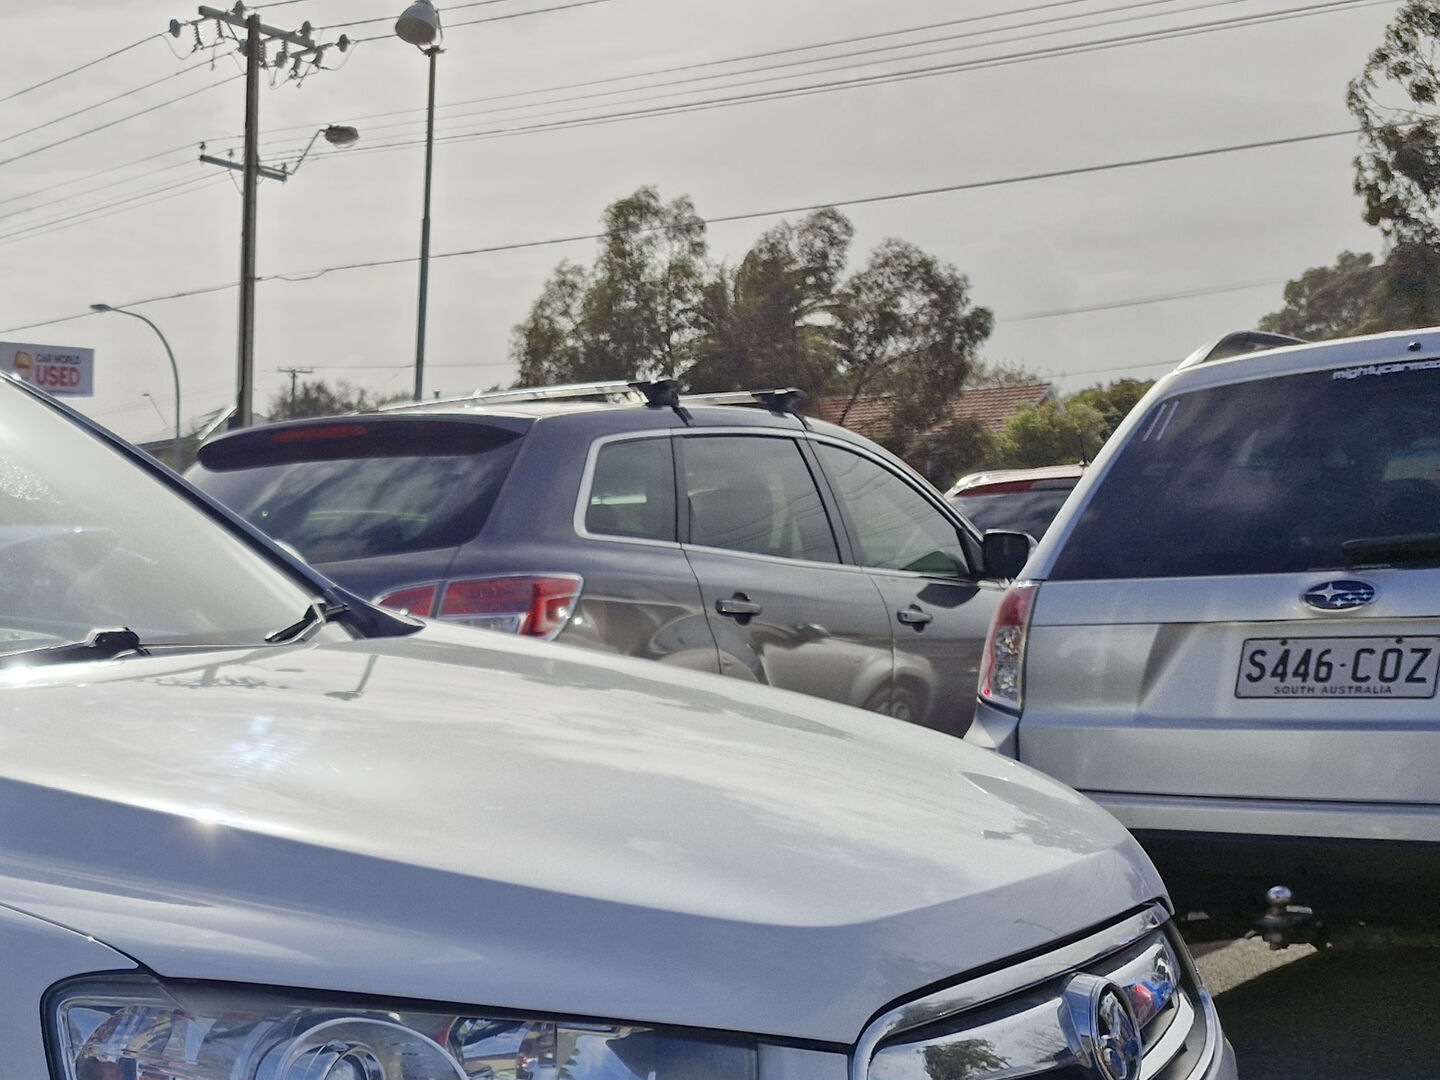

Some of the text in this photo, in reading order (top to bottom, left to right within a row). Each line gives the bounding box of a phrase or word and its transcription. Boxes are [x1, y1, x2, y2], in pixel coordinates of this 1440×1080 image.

[36, 364, 81, 388] USED
[1273, 684, 1393, 695] SOUTH AUSTRALIA
